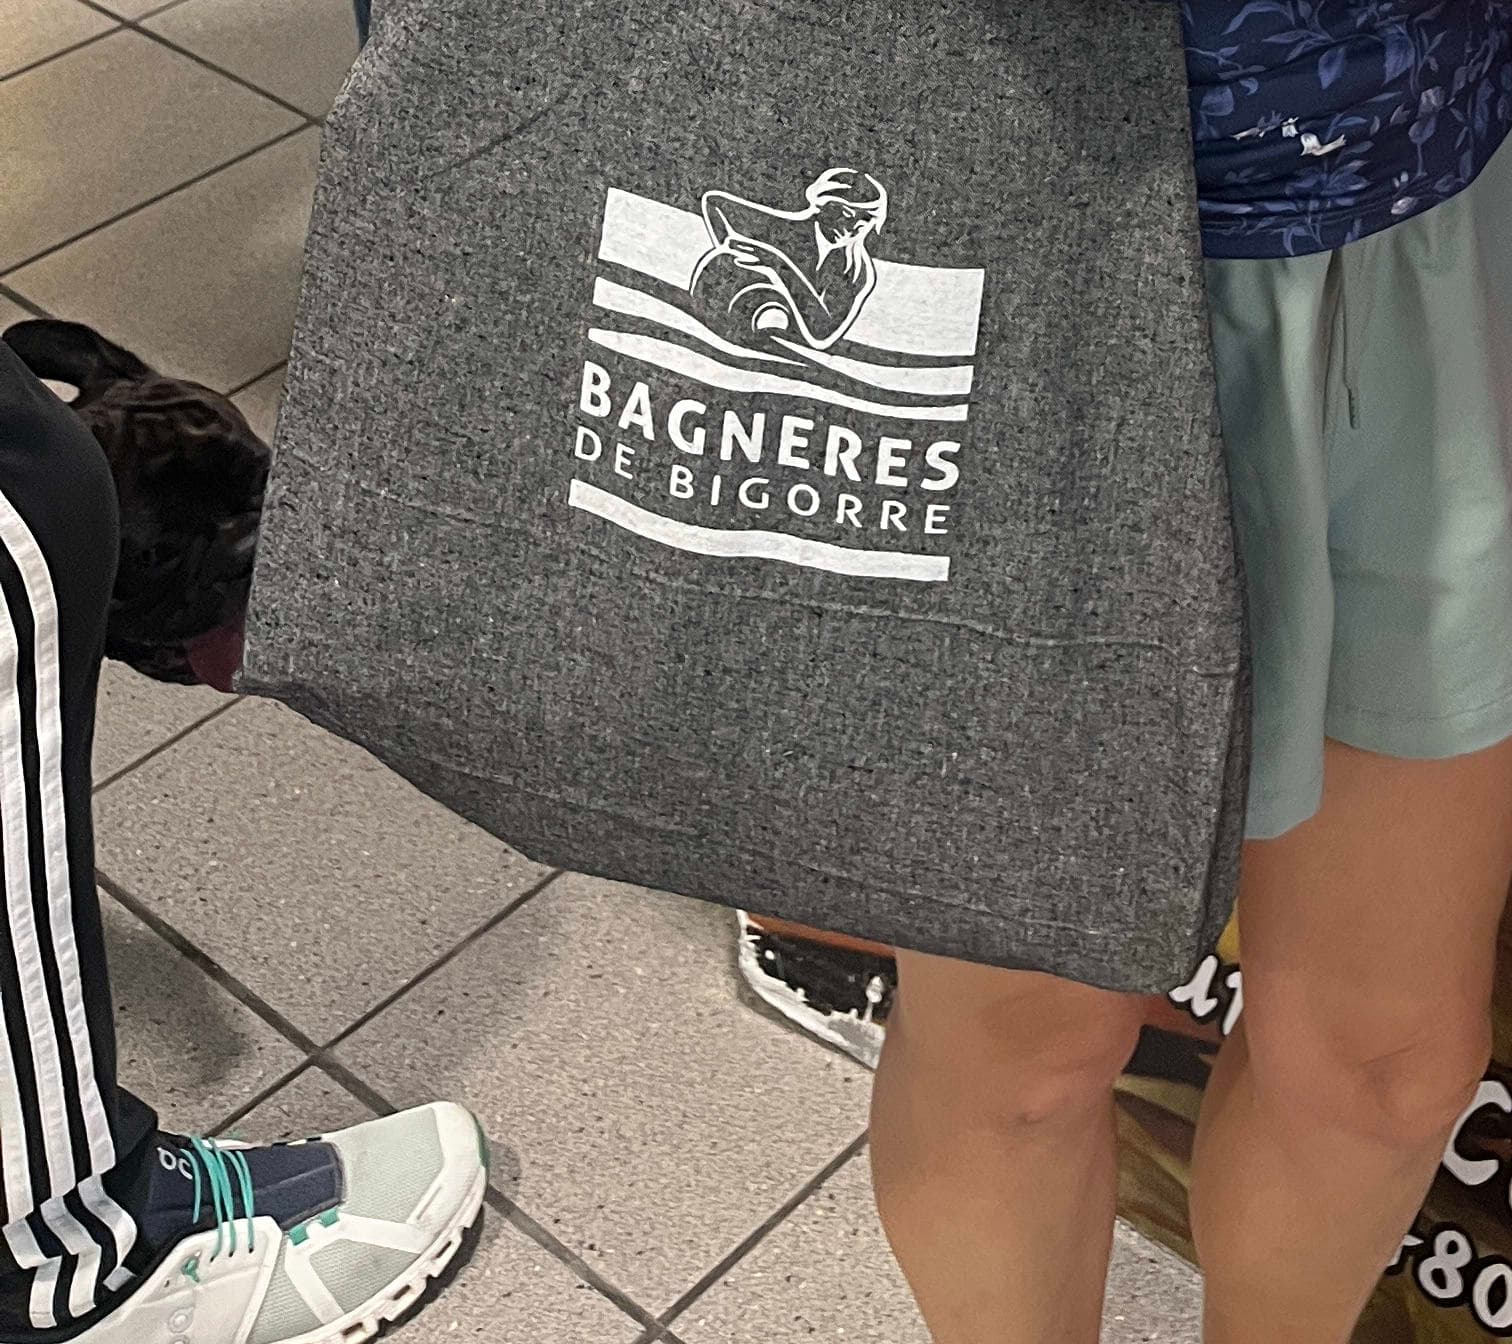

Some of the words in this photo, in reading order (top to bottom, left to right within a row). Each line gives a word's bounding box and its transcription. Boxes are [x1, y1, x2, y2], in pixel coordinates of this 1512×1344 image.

[574, 425, 636, 480] DE
[668, 464, 951, 535] BIGORRE
[579, 360, 961, 492] BAGNERES
